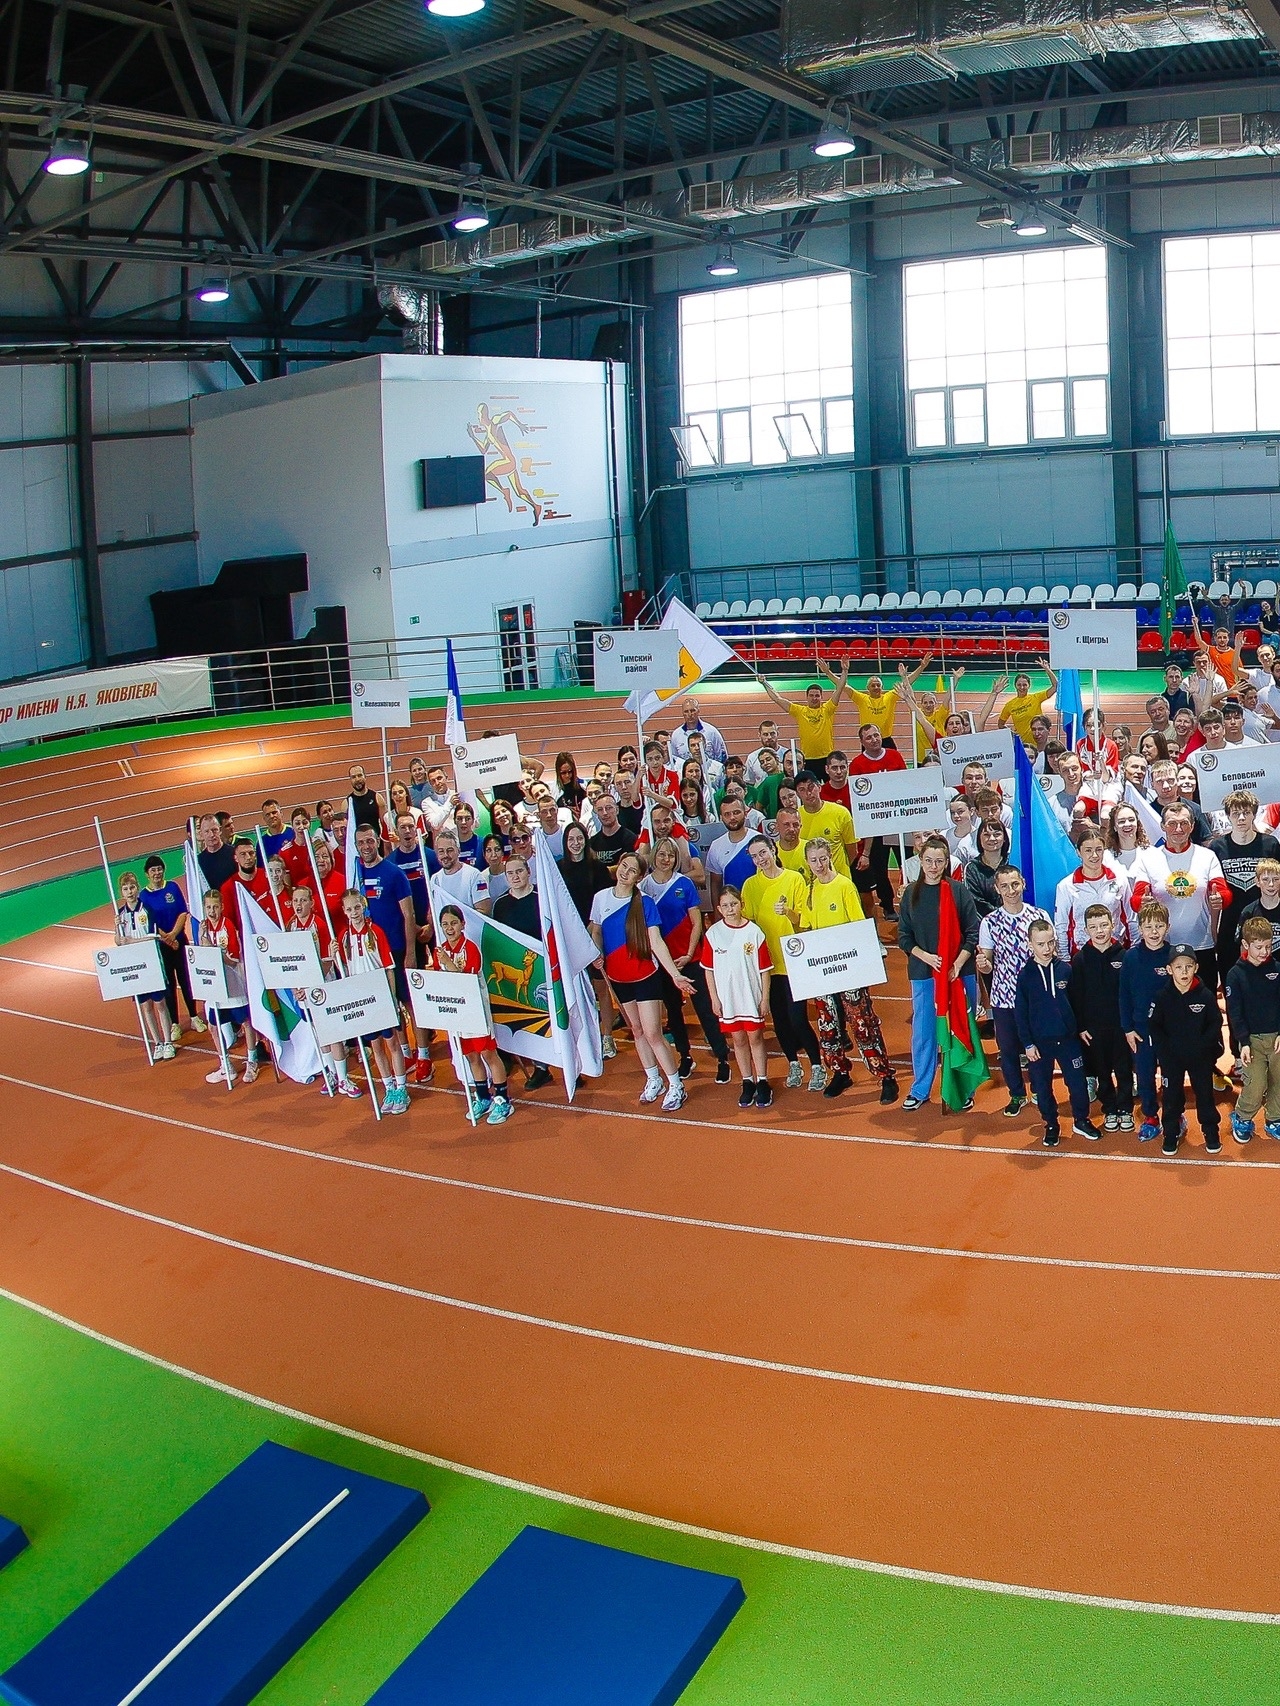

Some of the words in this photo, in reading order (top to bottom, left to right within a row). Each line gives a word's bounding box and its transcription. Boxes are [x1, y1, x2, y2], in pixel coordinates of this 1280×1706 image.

[1082, 636, 1109, 645] Щигры
[619, 653, 652, 663] Тимский
[625, 664, 648, 674] район
[16, 698, 60, 720] ИМЕНИ
[65, 693, 88, 711] Н.Я.
[95, 681, 158, 705] ЯКОВЛЕВА
[952, 753, 985, 765] Сеймский
[985, 751, 1003, 762] округ
[479, 766, 497, 775] район
[1222, 768, 1266, 782] Беловский
[1232, 781, 1257, 791] район
[858, 794, 939, 811] Железнодорожный
[870, 809, 892, 820] округ
[900, 806, 928, 818] Курска
[807, 949, 858, 967] Щигровский
[282, 964, 299, 973] район
[822, 963, 848, 976] район
[122, 973, 139, 983] район
[425, 993, 466, 1005] Медвенский
[326, 995, 377, 1016] Мантуровский
[438, 1004, 458, 1014] район
[343, 1010, 365, 1022] район
